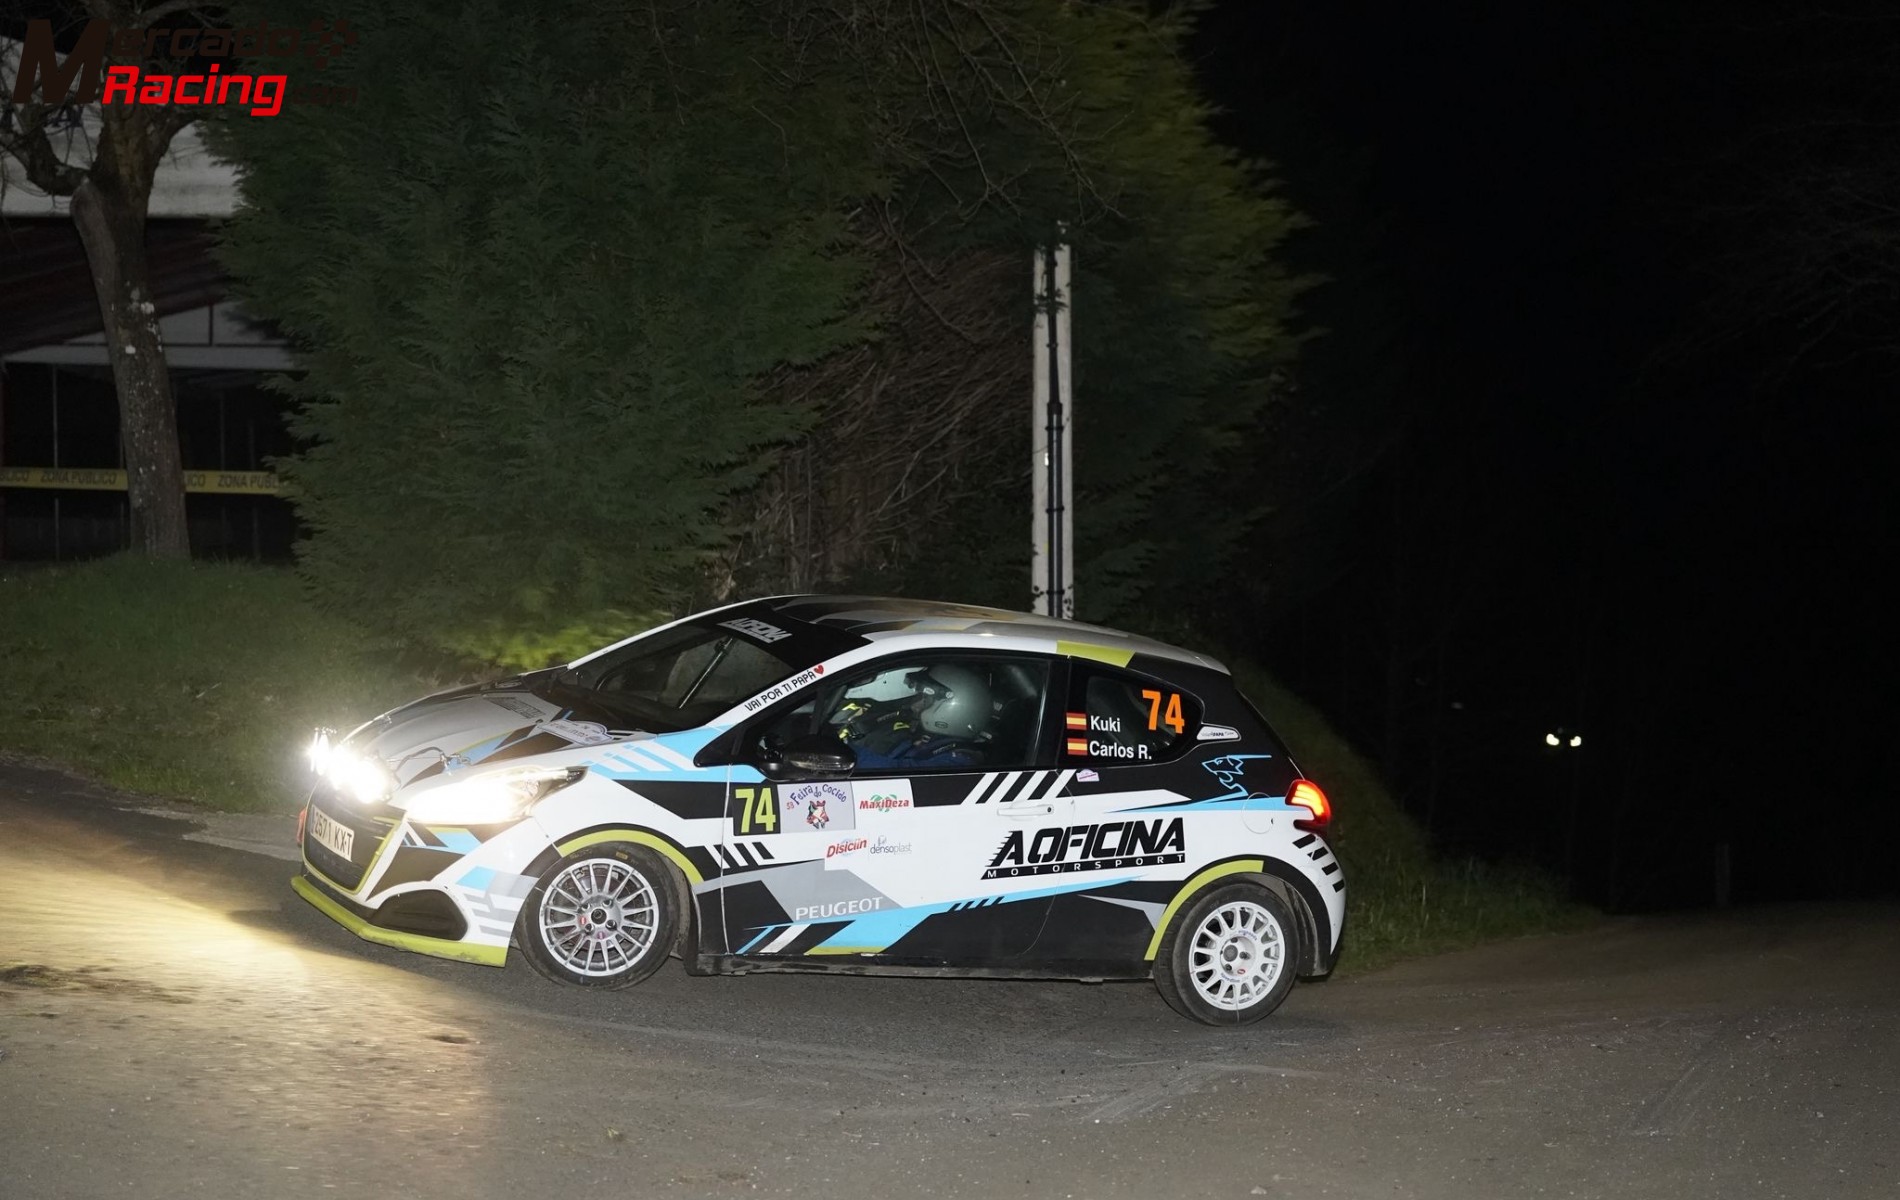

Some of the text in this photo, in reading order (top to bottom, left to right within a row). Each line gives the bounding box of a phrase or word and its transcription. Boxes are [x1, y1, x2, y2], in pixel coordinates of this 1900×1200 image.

[0, 470, 29, 483] BLICO
[40, 471, 68, 483] ZONA
[217, 474, 248, 488] ZONA
[250, 475, 279, 489] PUBL
[744, 698, 762, 712] VAI
[762, 688, 783, 704] POR
[782, 682, 792, 692] TI
[1142, 689, 1185, 734] 74
[1090, 715, 1121, 733] Kuki
[1089, 740, 1152, 760] Carlos R.
[789, 785, 813, 806] Feira
[813, 786, 822, 798] do
[822, 783, 847, 803] Cocido
[859, 799, 909, 810] MaxiDeza
[735, 787, 777, 833] 74
[334, 825, 352, 856] KXT
[870, 841, 912, 855] densoplast
[987, 854, 1184, 878] MOTORSPORT
[795, 896, 884, 921] PEUGEOT
